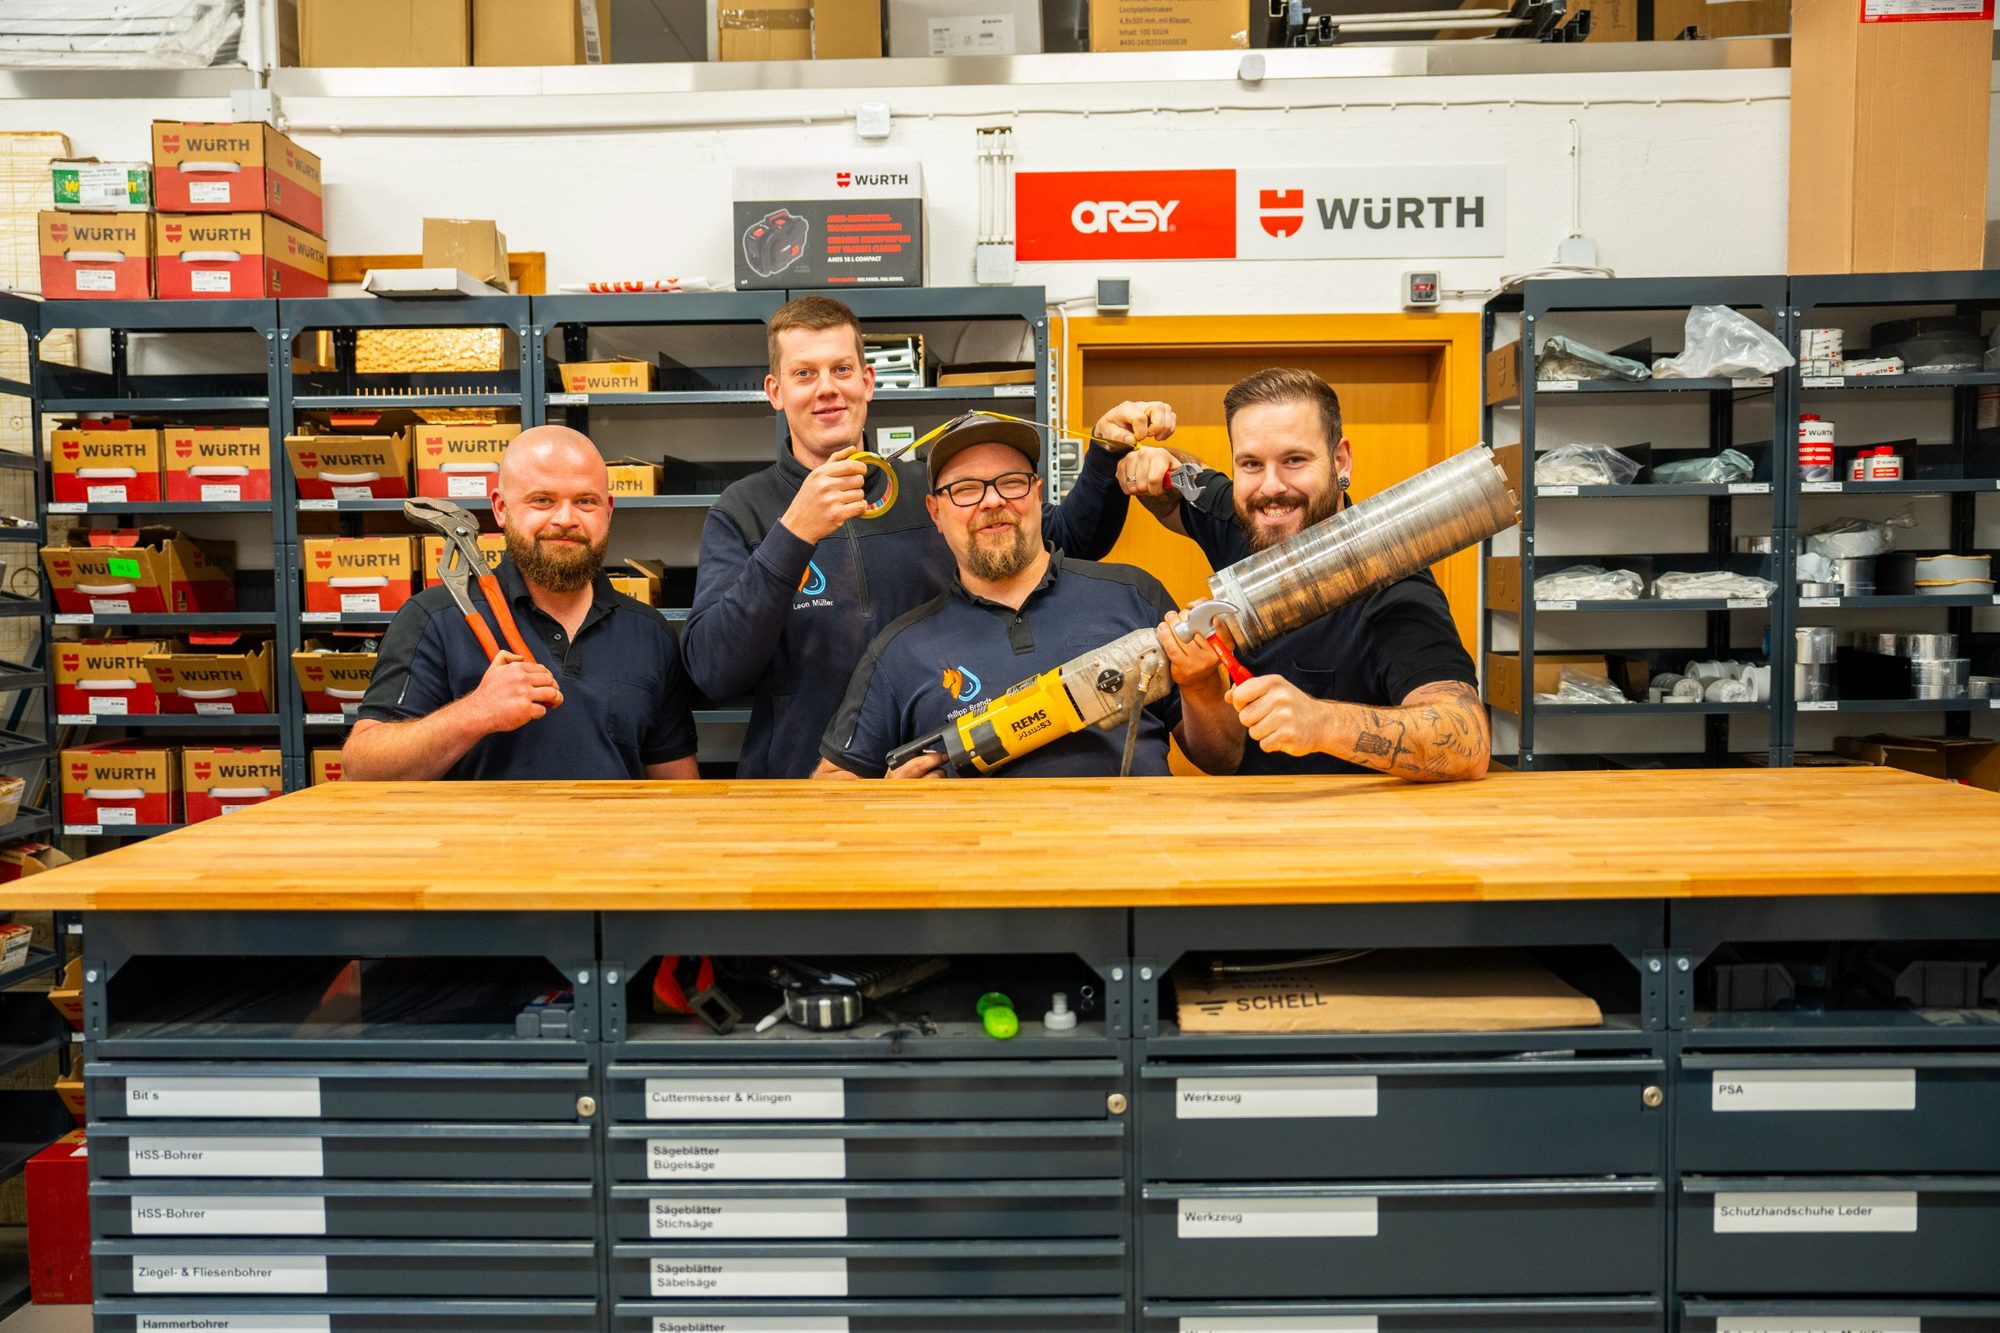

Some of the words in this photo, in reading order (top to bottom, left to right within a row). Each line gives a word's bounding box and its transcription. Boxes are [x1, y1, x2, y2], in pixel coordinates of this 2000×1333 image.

[186, 138, 250, 152] WÜRTH
[855, 174, 908, 186] WÜRTH
[1316, 196, 1484, 229] WÜRTH
[73, 227, 136, 241] WÜRTH
[189, 228, 251, 241] WÜRTH
[83, 444, 146, 457] WÜRTH
[199, 444, 260, 457] WÜRTH
[320, 454, 385, 467] WÜRTH
[337, 553, 400, 568] WÜRTH
[793, 601, 810, 610] Leon
[812, 598, 834, 608] Müller
[180, 670, 243, 681] WÜRTH
[1011, 709, 1047, 733] REMS
[94, 767, 156, 780] WÜRTH
[1236, 992, 1328, 1011] SCHELL
[1718, 1085, 1744, 1095] PSA
[652, 1092, 730, 1103] Cuttermesser
[735, 1092, 743, 1102] &
[747, 1092, 792, 1105] Klingen
[1183, 1092, 1242, 1104] Werkzeug
[135, 1149, 203, 1161] HSS-Bohrer
[653, 1146, 720, 1157] Sägeblätter
[654, 1159, 716, 1171] Bügelsäge
[137, 1208, 205, 1219] HSS-Bohrer
[655, 1204, 722, 1216] Sägeblätter
[1720, 1206, 1835, 1217] Schutzhandschuhe
[1838, 1206, 1873, 1217] Leder
[1184, 1211, 1243, 1224] Werkzeug
[656, 1218, 714, 1230] Stichsäge
[138, 1267, 178, 1279] Ziegel-
[181, 1267, 190, 1277] &
[193, 1267, 272, 1278] Fliesenbohrer
[657, 1263, 723, 1275] Sägeblätter
[657, 1277, 717, 1289] Säbelsäge
[142, 1319, 229, 1329] Hammerbohrer
[659, 1322, 725, 1333] Sägeblätter
